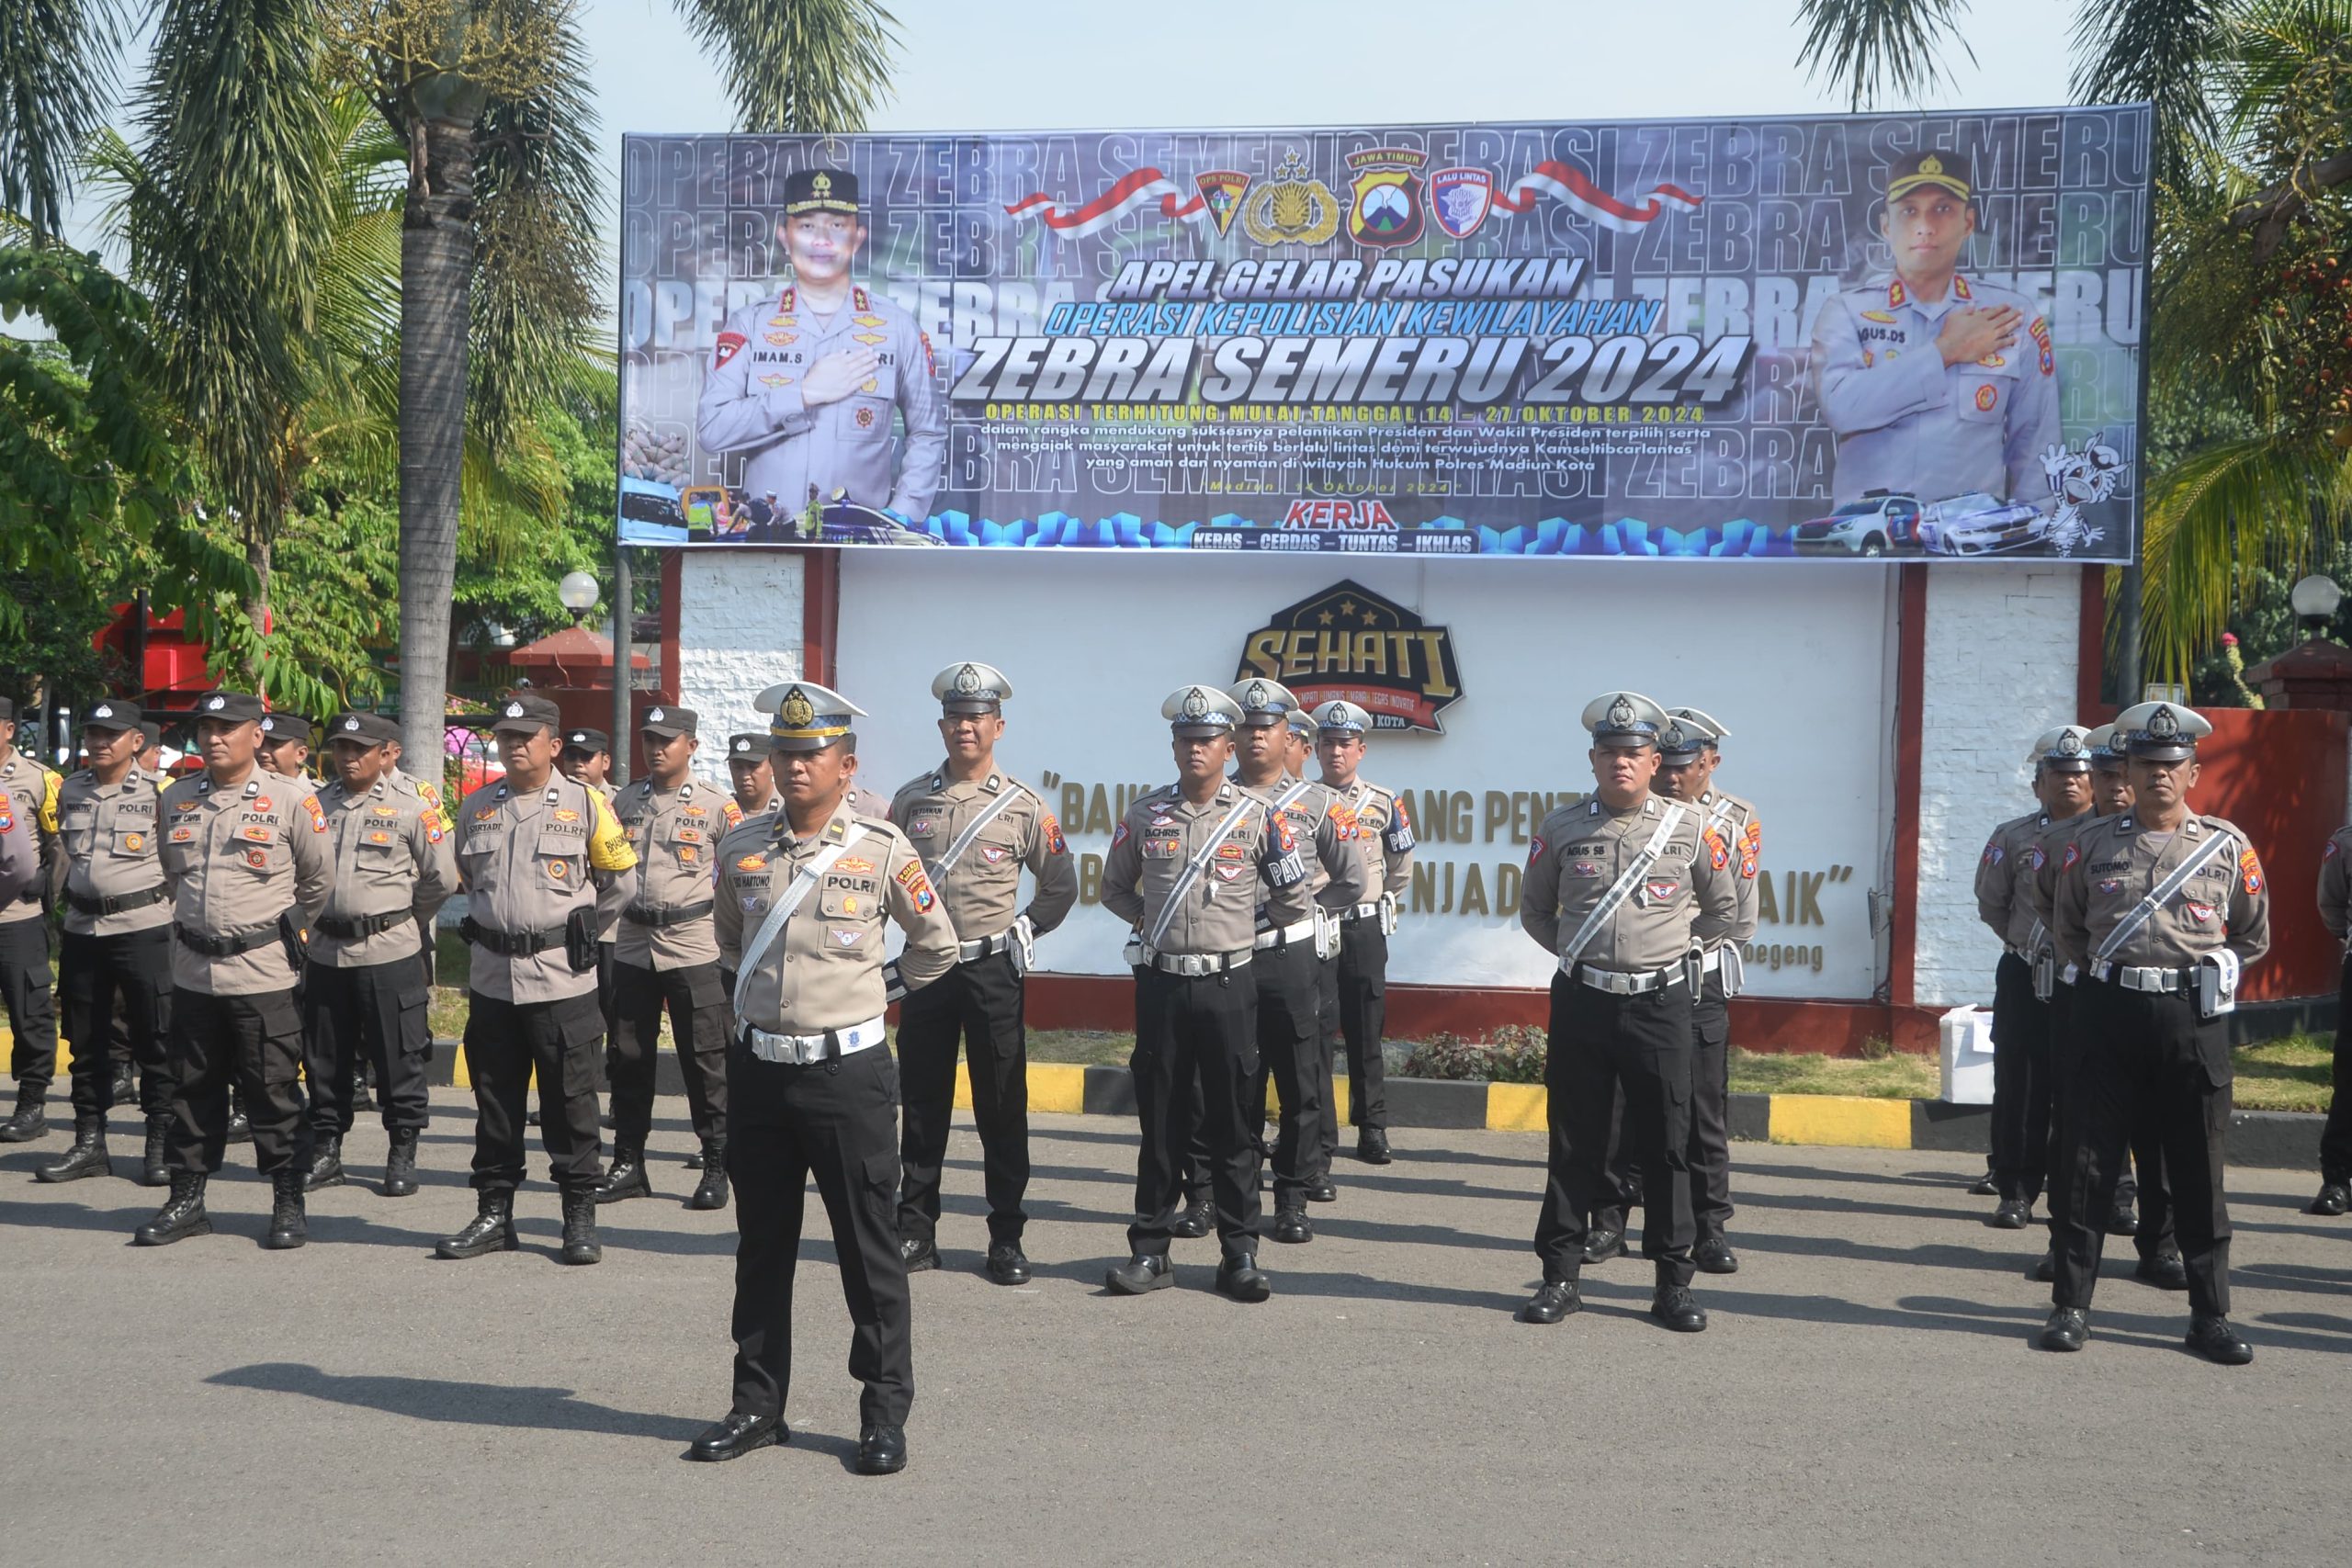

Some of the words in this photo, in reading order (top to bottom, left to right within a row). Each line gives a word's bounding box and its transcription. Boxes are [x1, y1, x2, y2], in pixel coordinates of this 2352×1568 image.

[1353, 152, 1384, 166] JAWA
[1385, 152, 1421, 165] TIMUR
[1635, 123, 1852, 197] ZEBRA
[1200, 175, 1216, 185] OPS
[1219, 174, 1246, 185] POLRI
[1437, 174, 1458, 184] LALU
[1459, 173, 1487, 184] LINTAS
[1106, 260, 1216, 300] APEL
[1220, 258, 1363, 300] GELAR
[1363, 258, 1587, 299] PASUKAN
[1044, 302, 1195, 336] OPERASI
[1197, 301, 1404, 336] KEPOLISIAN
[1405, 300, 1661, 335] KEWILAYAHAN
[753, 350, 802, 364] IMAM.S
[950, 336, 1195, 400] ZEBRA
[1201, 336, 1530, 403] SEMERU
[1523, 334, 1752, 404] 2024
[986, 403, 1081, 420] OPERASI
[1091, 404, 1218, 422] TERHITUNG
[1230, 405, 1300, 422] MULAI
[1311, 405, 1415, 423] TANGGAL
[1426, 406, 1452, 423] 14
[1486, 405, 1512, 423] 27
[1521, 406, 1631, 423] OKTOBER
[1642, 406, 1704, 423] 2024
[981, 423, 1028, 434] dalam
[1035, 423, 1090, 437] rangka
[1095, 424, 1186, 437] mendukung
[1192, 424, 1273, 438] suksesnya
[1278, 425, 1363, 438] pelantikan
[1368, 425, 1437, 437] Presiden
[1442, 426, 1473, 437] dan
[1478, 426, 1525, 437] Wakil
[1531, 426, 1601, 438] Presiden
[1606, 426, 1664, 441] terpilih
[1669, 427, 1711, 438] serta
[997, 438, 1074, 453] mengajak
[1079, 439, 1173, 454] masyarakat
[1178, 441, 1221, 452] untuk
[1227, 441, 1269, 453] tertib
[1273, 441, 1329, 453] berlalu
[1334, 442, 1375, 453] lintas
[1381, 442, 1420, 454] demi
[1425, 443, 1530, 457] terwujudnya
[1535, 443, 1692, 455] Kamseltibcarlantas
[1086, 459, 1125, 469] yang
[1129, 459, 1173, 468] aman
[1179, 457, 1208, 468] dan
[1213, 459, 1277, 470] nyaman
[1283, 457, 1297, 468] di
[1303, 458, 1367, 471] wilayah
[1373, 458, 1430, 469] Hukum
[1435, 458, 1485, 469] Polres
[1490, 459, 1551, 470] Madiun
[1556, 459, 1595, 471] Kota
[1283, 500, 1397, 531] KERJA
[1194, 533, 1243, 549] KERAS
[1260, 534, 1320, 550] CERDAS
[1339, 535, 1398, 552] TUNTAS
[1416, 535, 1472, 553] IKHLAS
[1240, 629, 1457, 698] SEHATI
[1377, 716, 1406, 728] KOTA
[119, 804, 153, 815] POLRI
[242, 814, 278, 825] POLRI
[364, 818, 398, 829] POLRI
[675, 817, 708, 829] POLRI
[546, 824, 585, 836] POLRI
[1566, 845, 1589, 857] AGUS
[828, 875, 876, 893] POLRI
